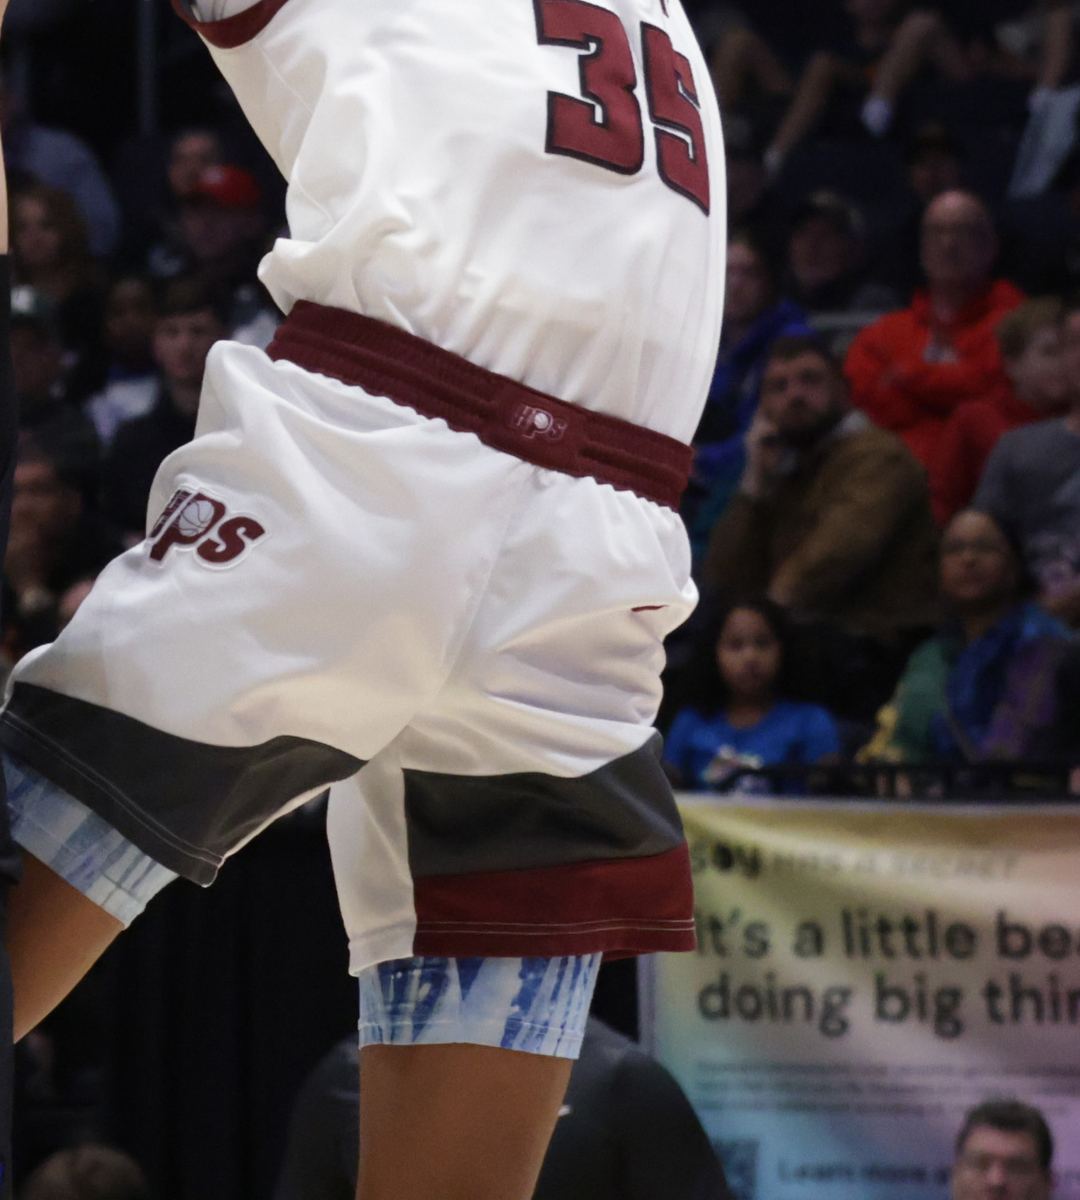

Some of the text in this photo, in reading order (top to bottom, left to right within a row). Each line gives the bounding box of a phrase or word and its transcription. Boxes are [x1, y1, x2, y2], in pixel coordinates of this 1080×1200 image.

[793, 920, 825, 959] a
[841, 907, 977, 960] little
[996, 907, 1080, 960] be
[696, 971, 852, 1039] doing
[874, 971, 965, 1040] big
